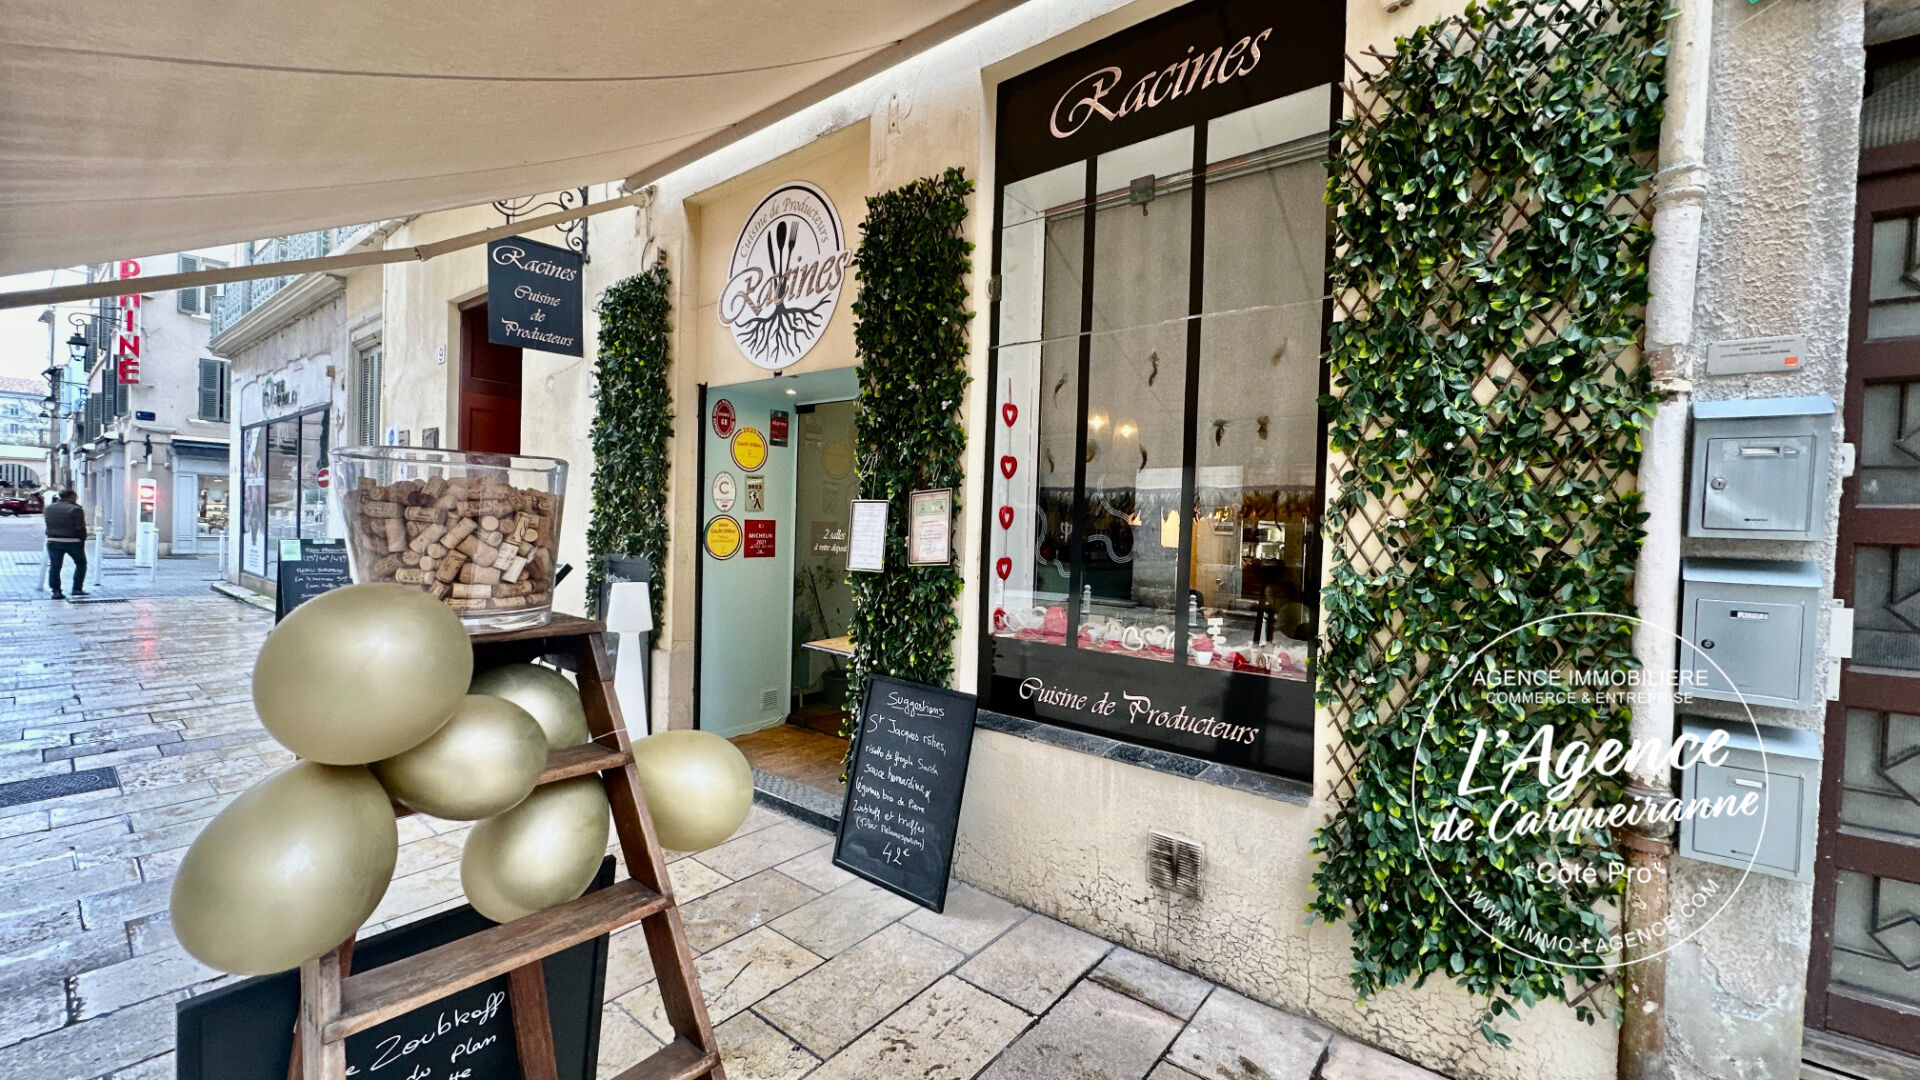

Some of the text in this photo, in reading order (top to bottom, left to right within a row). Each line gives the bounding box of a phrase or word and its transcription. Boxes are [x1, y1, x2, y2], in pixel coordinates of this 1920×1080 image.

[1050, 27, 1273, 138] Racines
[740, 197, 829, 258] Cuisine de Producteurs
[492, 245, 578, 281] Racines
[514, 285, 561, 307] Cuisine
[719, 250, 850, 324] Racines
[529, 308, 546, 322] de
[501, 317, 574, 347] Producteurs
[886, 691, 945, 717] Suggestions
[1019, 677, 1260, 745] Cuisine de Producteurs
[888, 719, 919, 744] Jacques
[882, 788, 894, 802] bio
[370, 990, 506, 1072] Zoubkoff
[451, 1034, 497, 1063] plan
